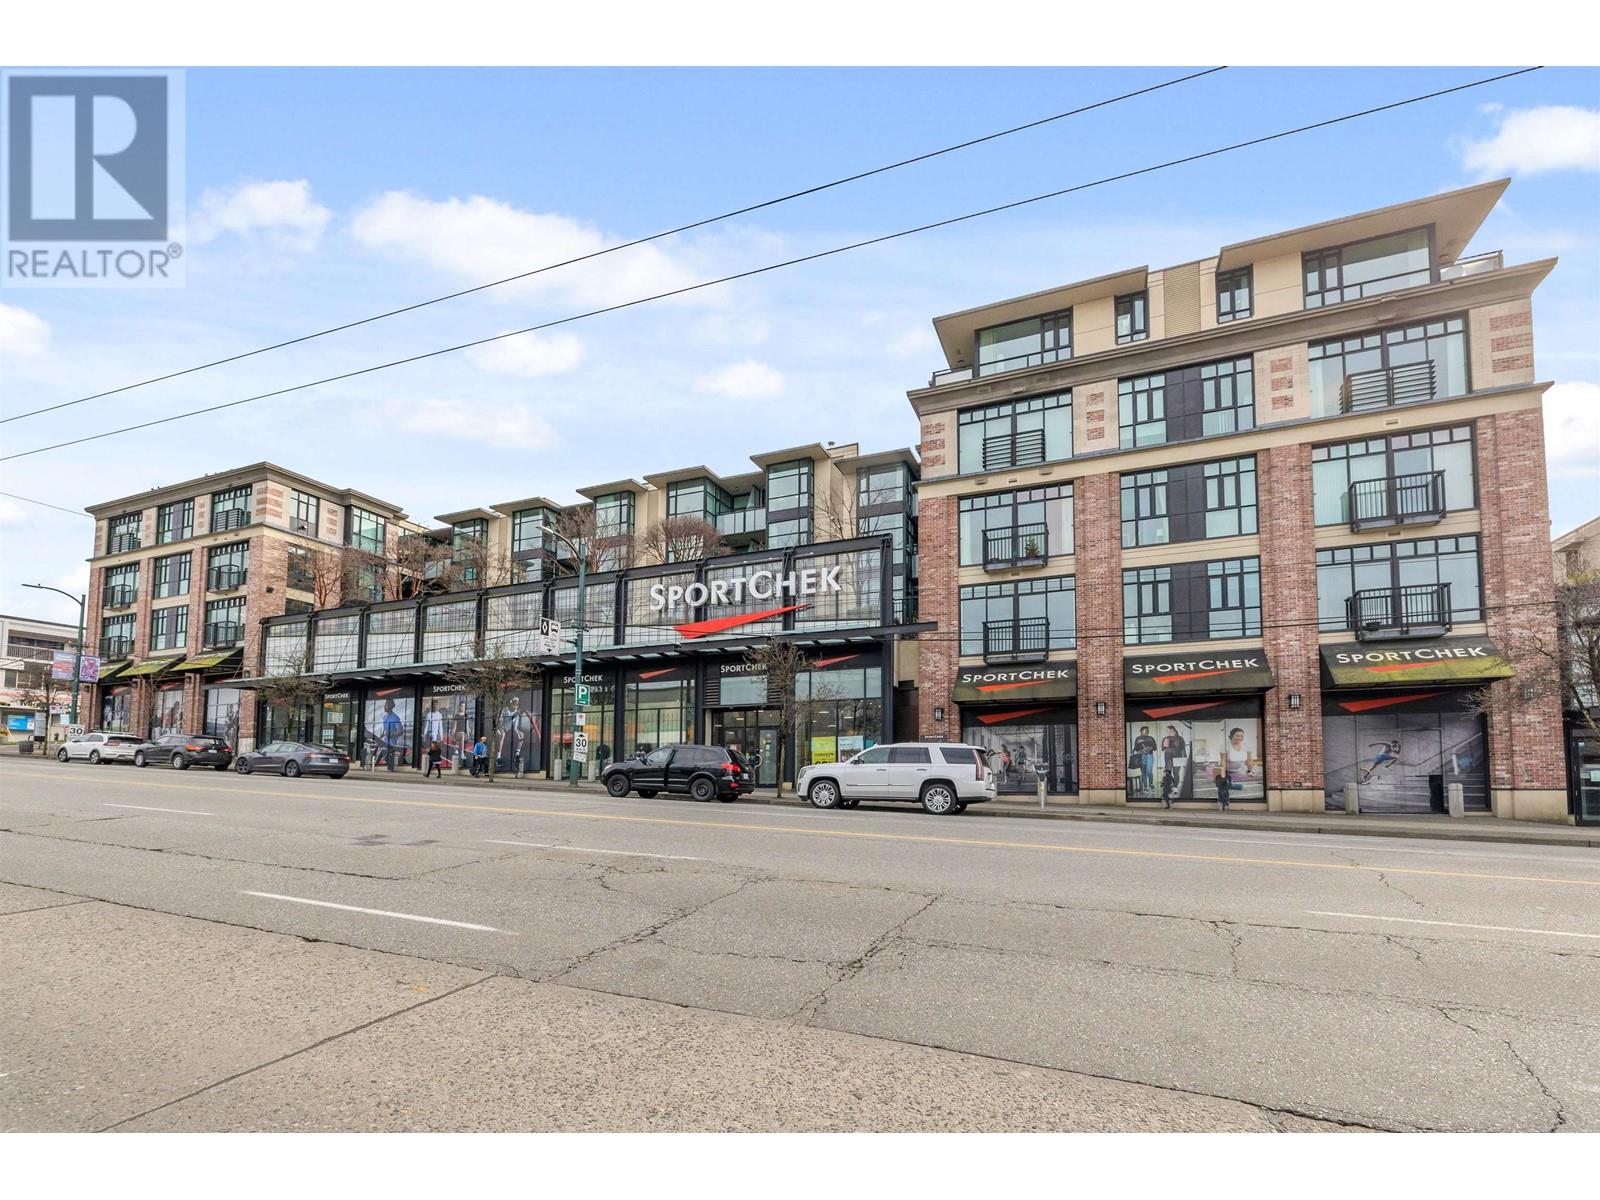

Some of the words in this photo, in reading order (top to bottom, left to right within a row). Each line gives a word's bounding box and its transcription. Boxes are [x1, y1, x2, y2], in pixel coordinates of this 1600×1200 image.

[650, 565, 842, 611] SPORTCHEK
[1336, 647, 1488, 664] SPORTCHEK
[720, 663, 768, 673] SPORTCHEK
[1131, 658, 1260, 674] SPORTCHEK
[563, 674, 603, 684] SPOTCHEK
[962, 669, 1070, 684] SPORTCHEK
[578, 686, 588, 699] P
[69, 727, 83, 735] 30
[575, 738, 587, 748] 30
